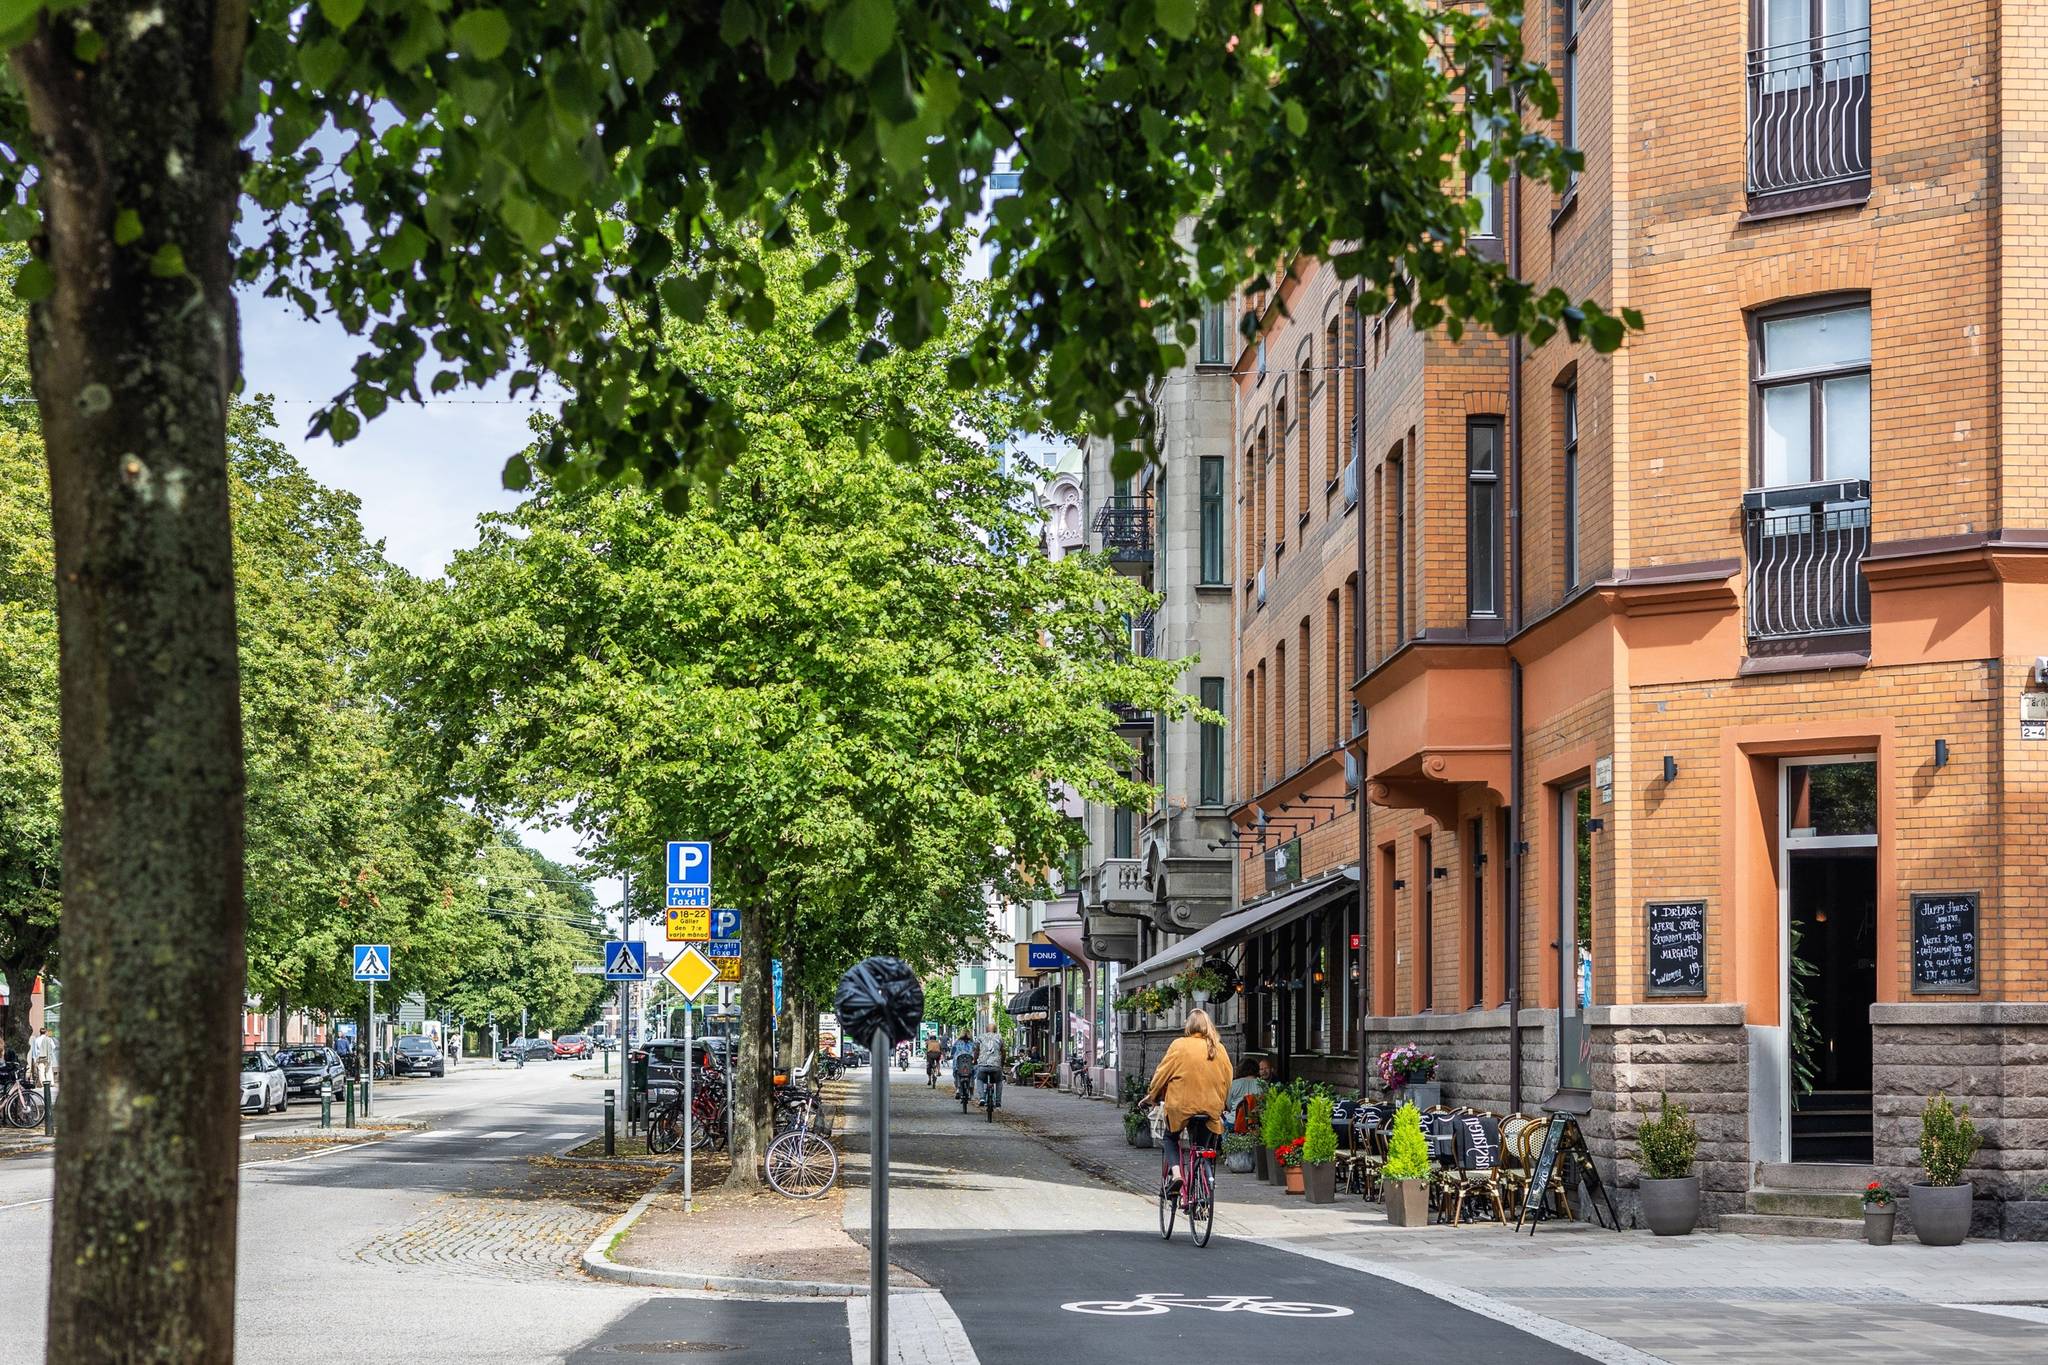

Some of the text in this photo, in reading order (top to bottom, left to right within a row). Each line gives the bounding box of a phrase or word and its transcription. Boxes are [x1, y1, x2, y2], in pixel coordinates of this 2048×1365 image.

[2024, 728, 2044, 737] 2-4
[678, 846, 703, 881] P
[673, 888, 704, 897] Avgift
[672, 898, 706, 906] Taxa E
[718, 911, 736, 938] P
